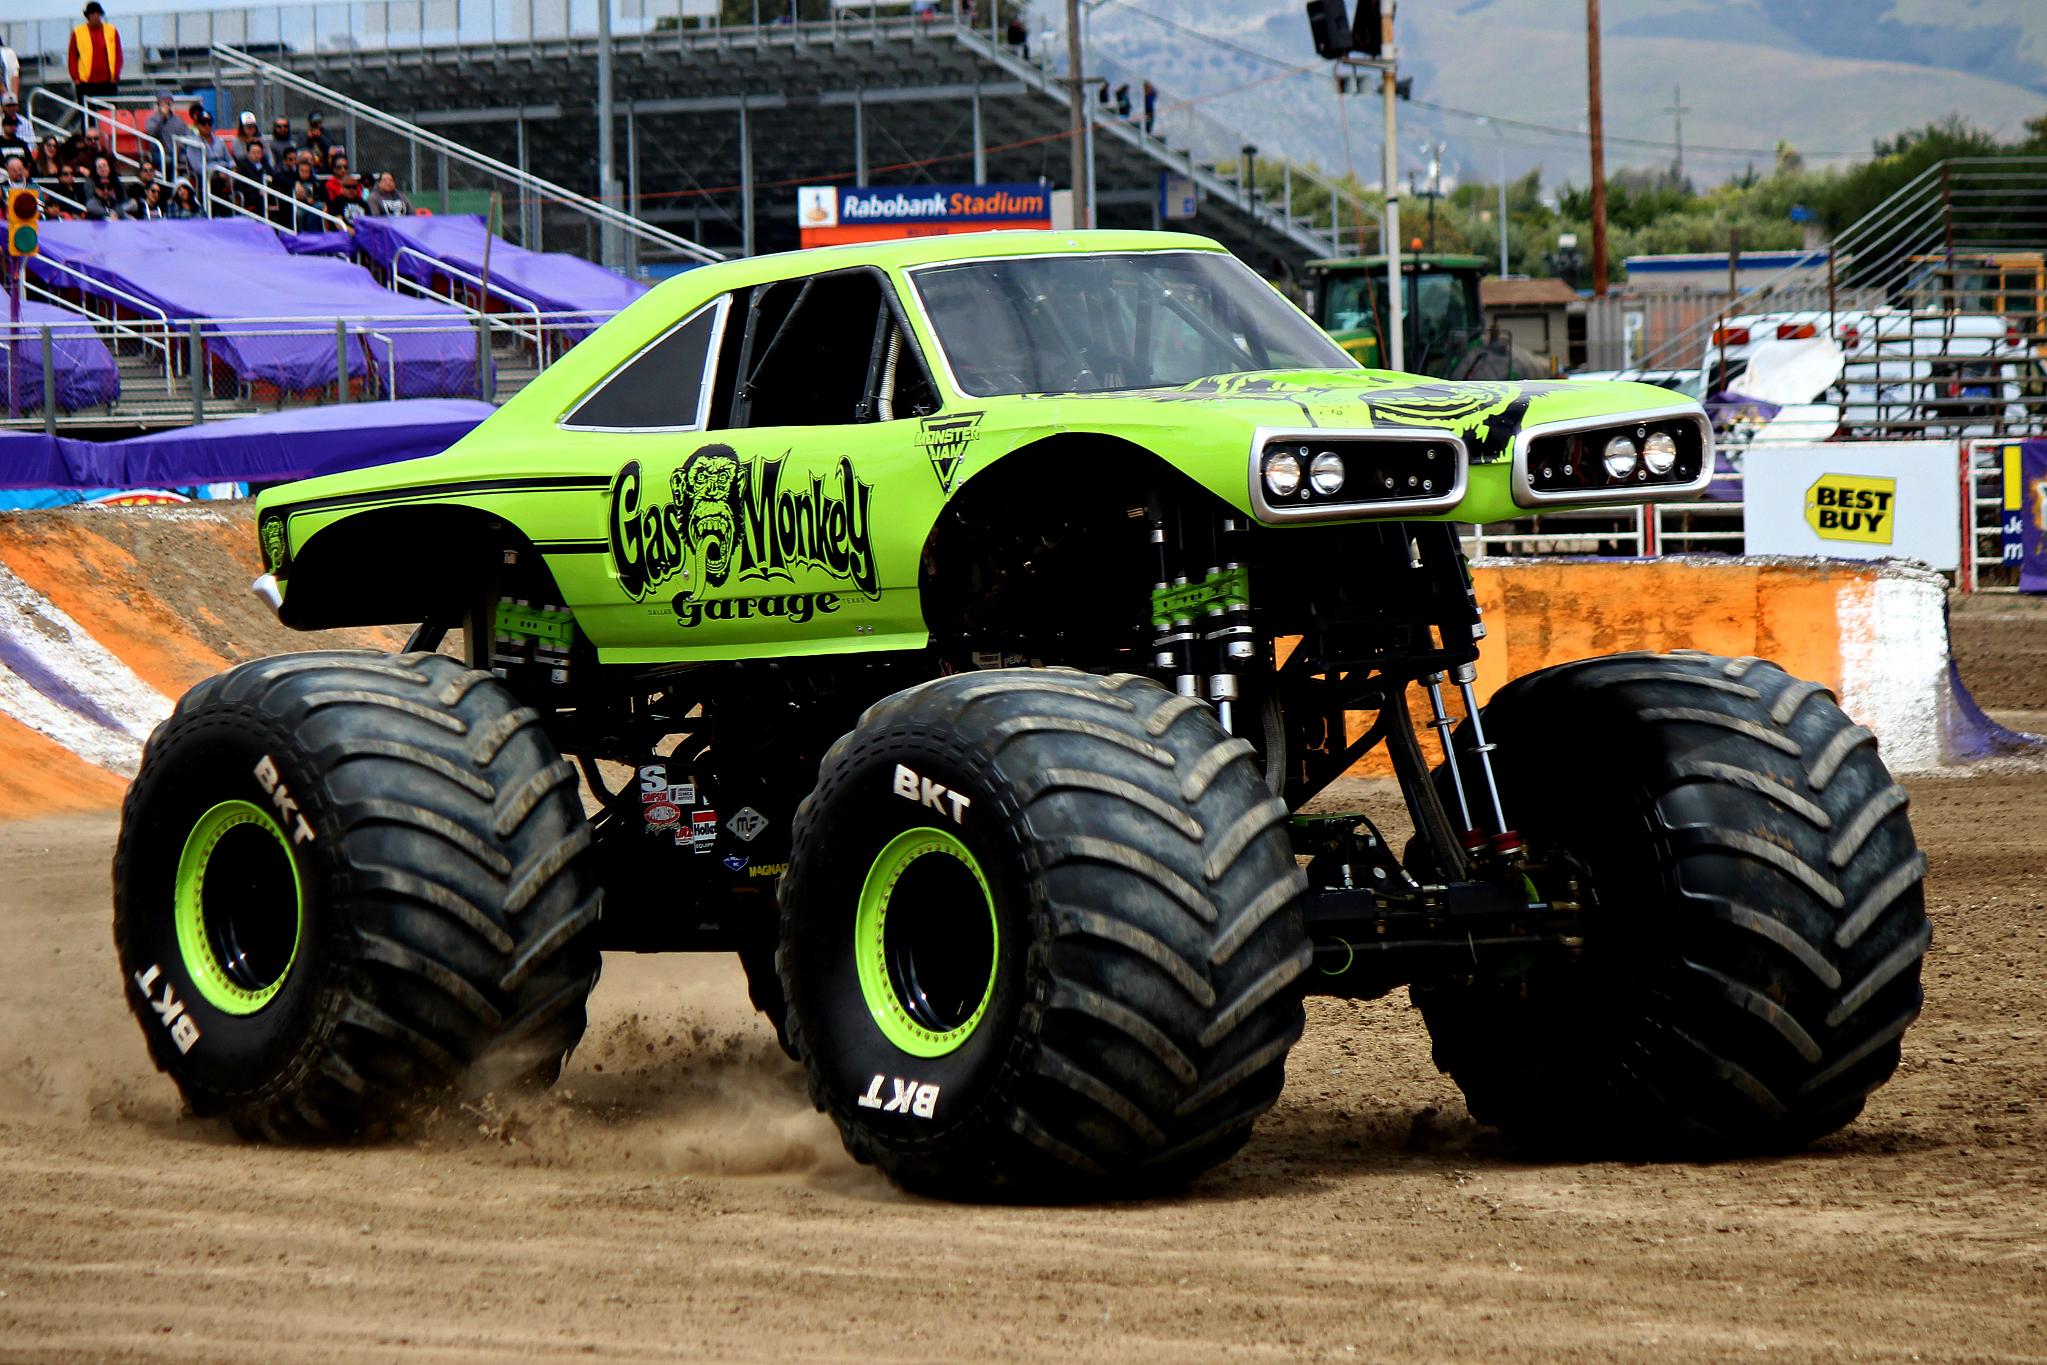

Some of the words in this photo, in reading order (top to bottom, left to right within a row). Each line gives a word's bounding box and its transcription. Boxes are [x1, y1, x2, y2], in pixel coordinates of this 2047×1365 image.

[844, 192, 947, 218] Rabobank
[950, 192, 1043, 214] Stadium
[914, 426, 981, 447] MONSTER
[929, 443, 966, 460] JAM
[1816, 486, 1893, 511] BEST
[608, 459, 685, 604] Gas
[739, 448, 881, 603] Monkey
[1818, 510, 1885, 533] BUY
[647, 608, 672, 616] DALLAS
[672, 591, 841, 628] Garage
[639, 765, 668, 793] S
[252, 754, 316, 846] BKT
[892, 763, 971, 825] BKT
[133, 963, 201, 1056] BKT
[857, 1074, 941, 1119] BKT
